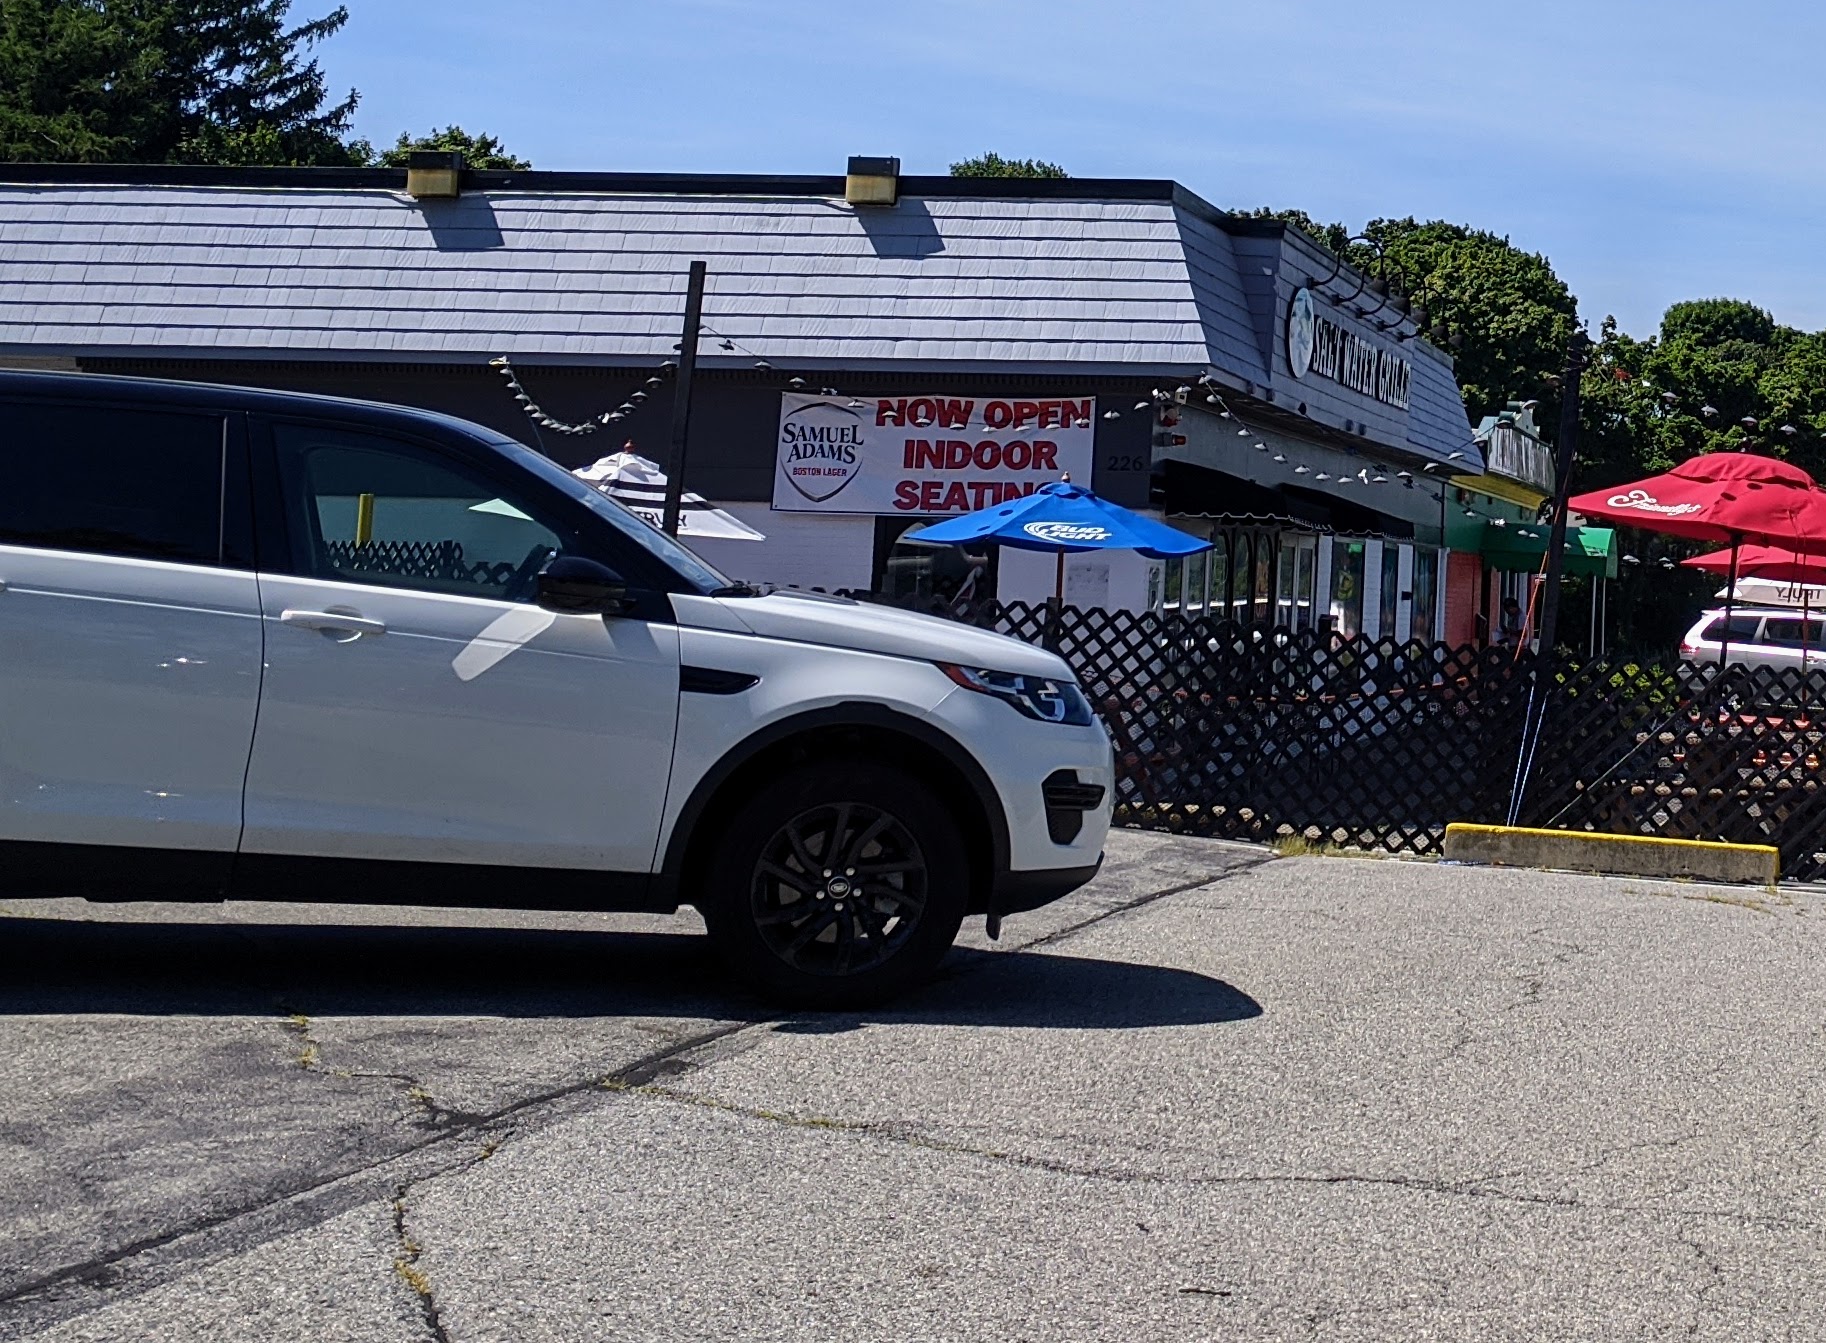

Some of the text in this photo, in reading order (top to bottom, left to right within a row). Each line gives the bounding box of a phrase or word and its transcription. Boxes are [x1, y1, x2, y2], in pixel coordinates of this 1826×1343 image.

[1343, 334, 1377, 398] WATER
[875, 399, 1091, 430] NOW OPEN
[782, 422, 864, 446] SAMUEL
[786, 443, 856, 465] ADAMS
[903, 439, 1058, 470] INDOOR
[1107, 455, 1143, 471] 226
[792, 467, 847, 477] BOSTON LAGER
[892, 480, 1051, 512] SEATIN
[1036, 528, 1113, 540] LIGHT
[1049, 523, 1106, 534] BUD
